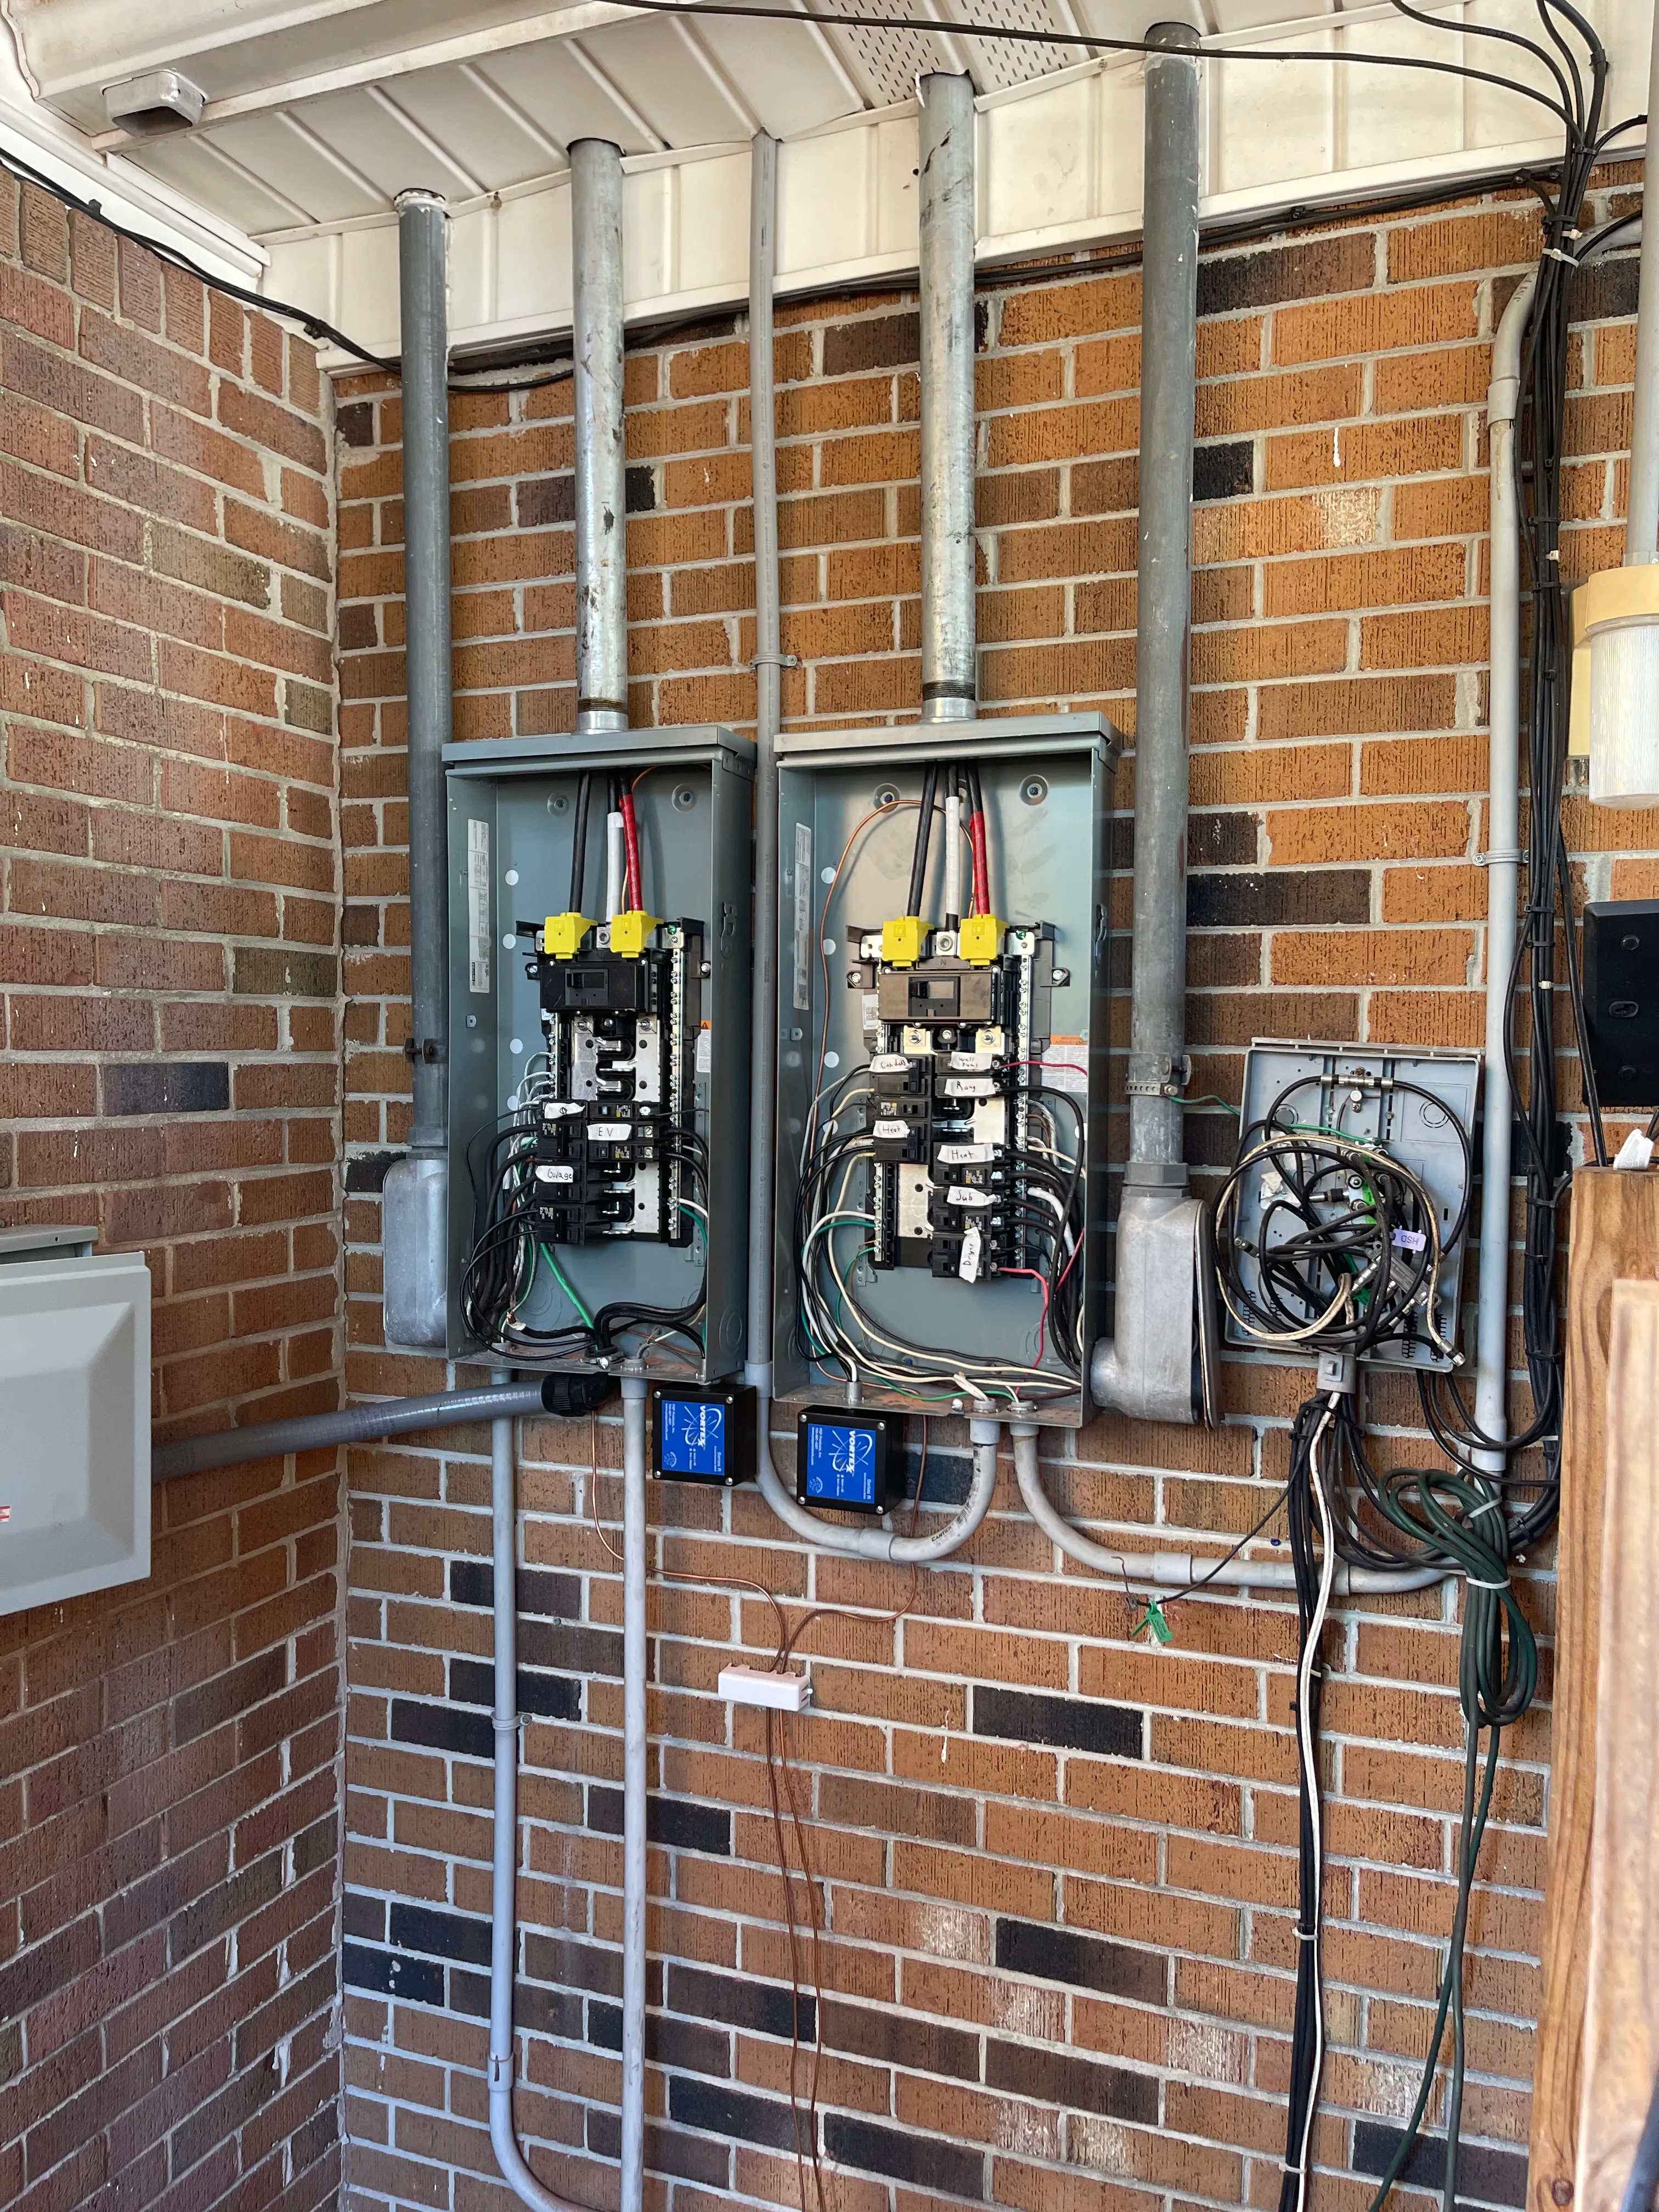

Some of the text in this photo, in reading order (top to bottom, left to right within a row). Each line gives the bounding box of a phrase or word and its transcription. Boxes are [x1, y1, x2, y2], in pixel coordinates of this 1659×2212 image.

[547, 1167, 572, 1181] Garage
[956, 1189, 973, 1201] Sub
[1401, 1235, 1419, 1245] HSD
[962, 1243, 975, 1266] Dryer
